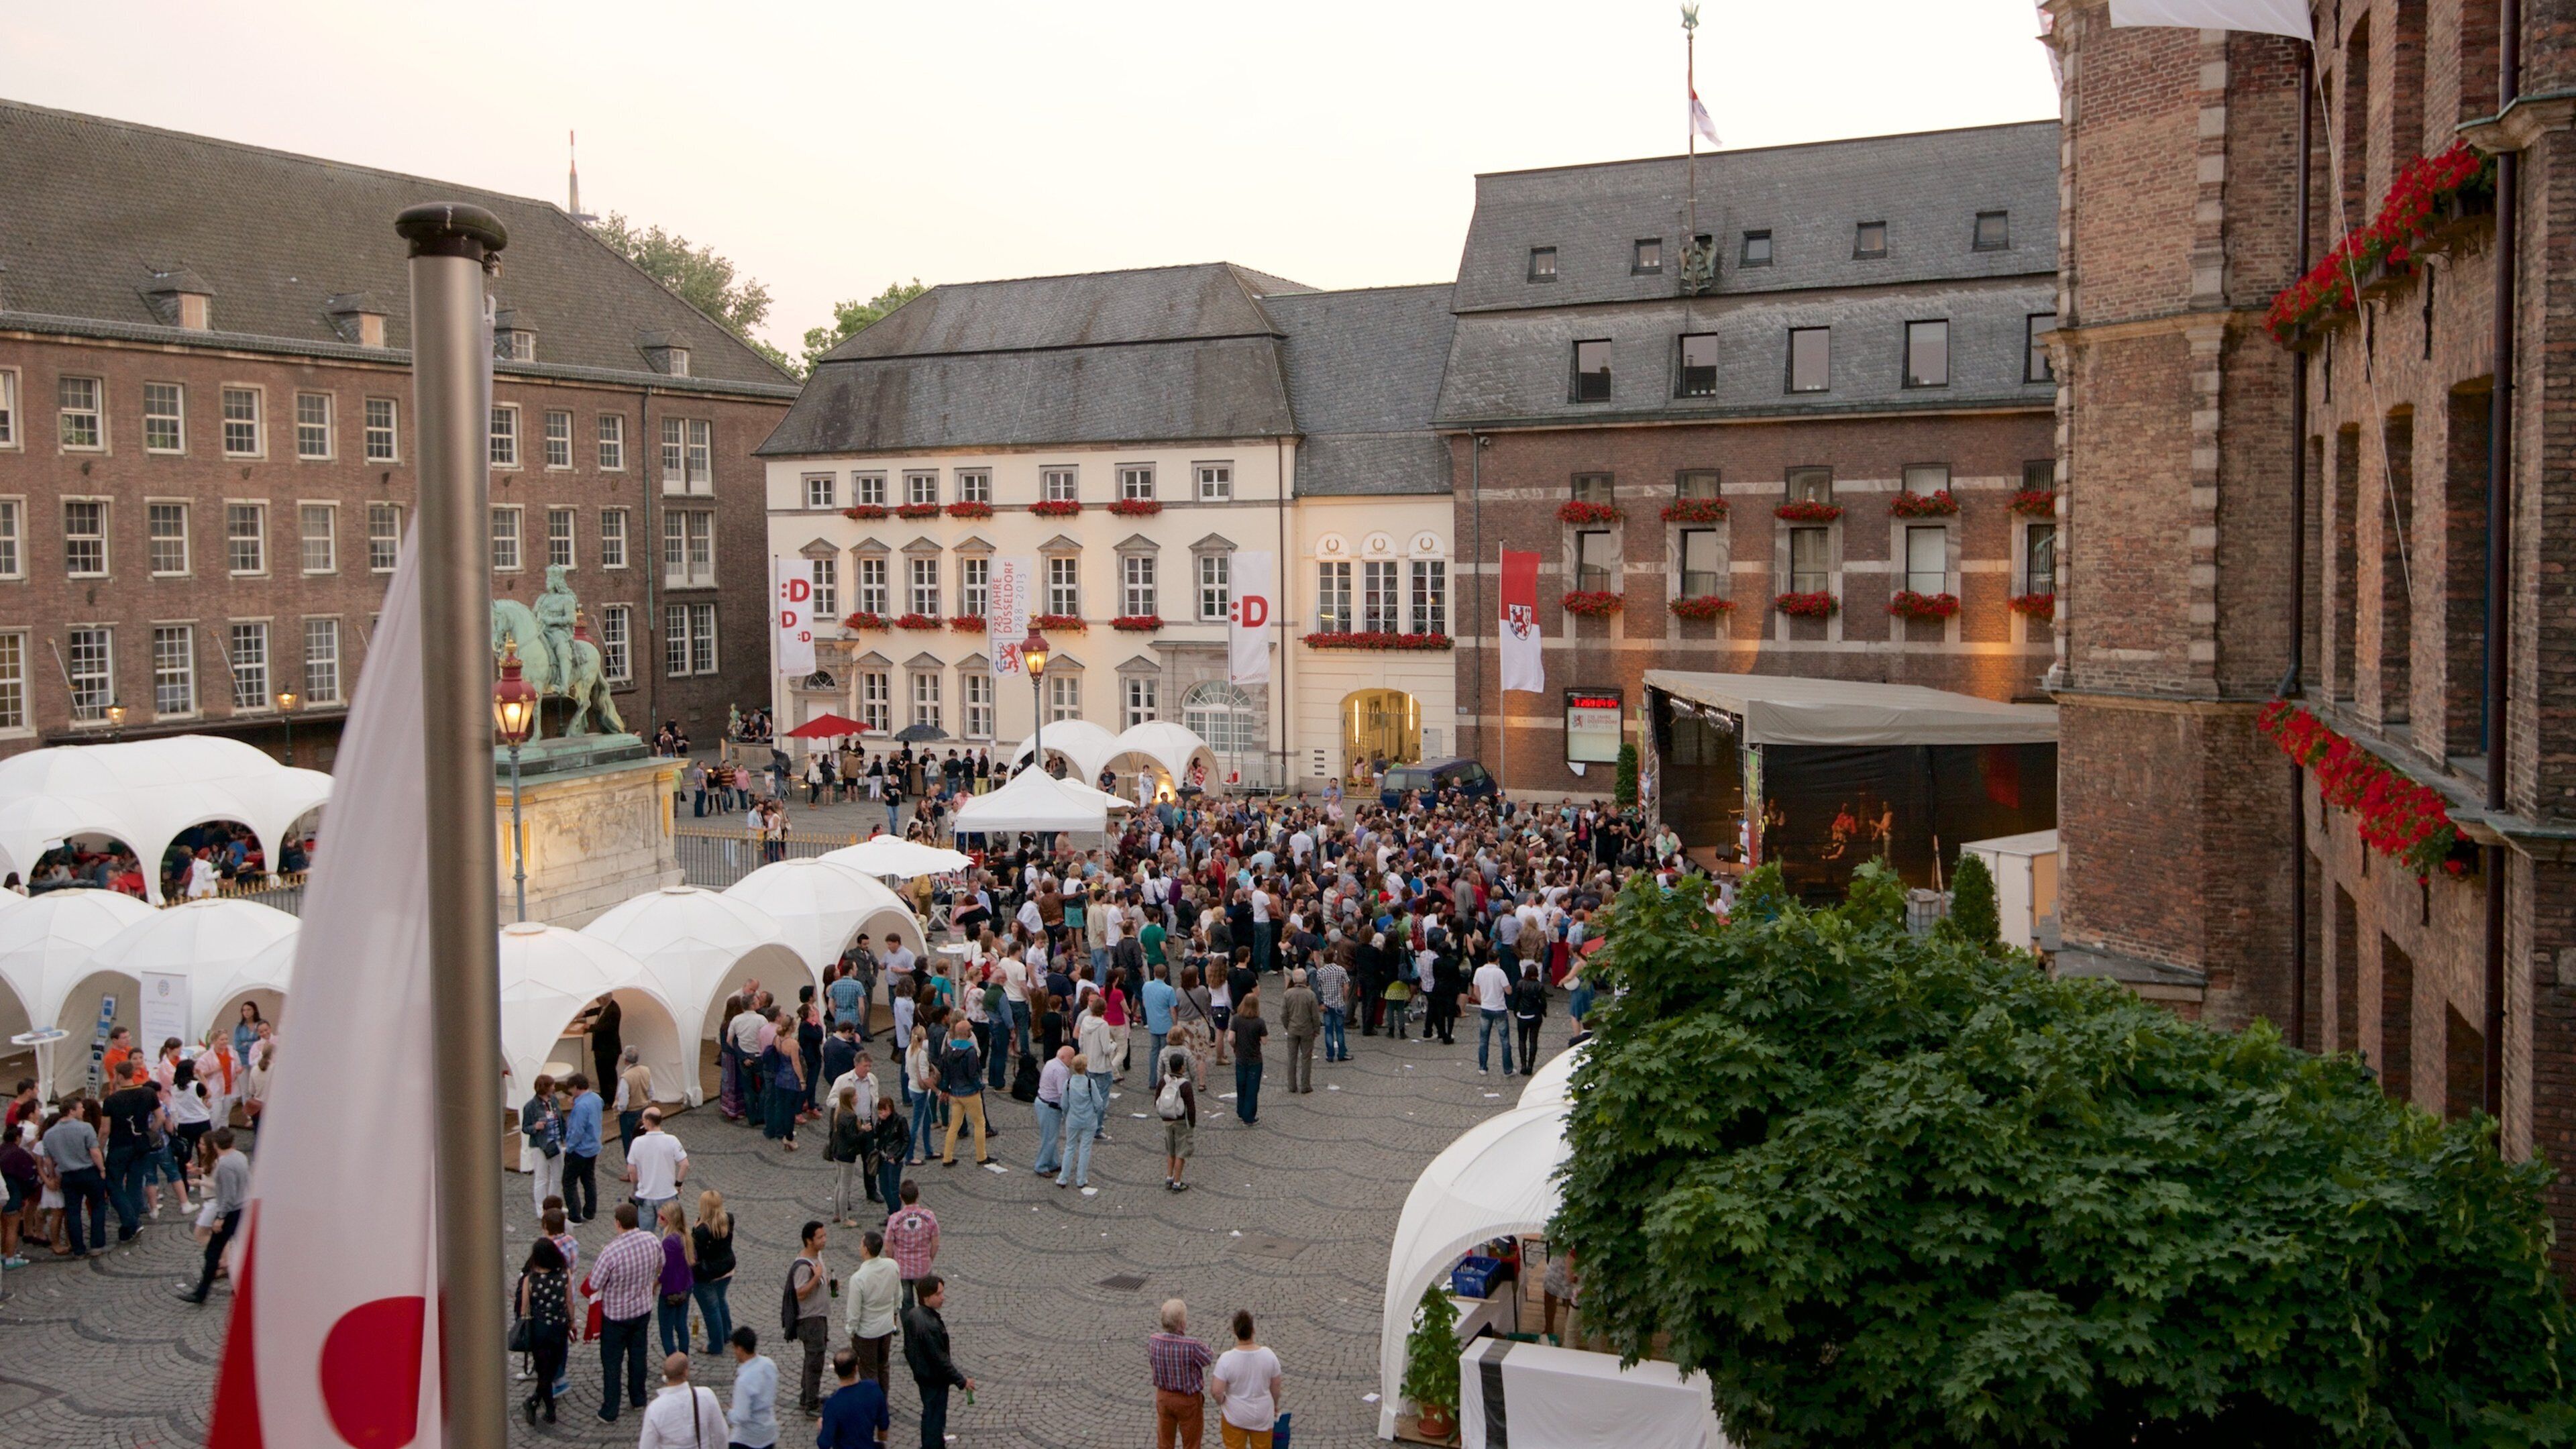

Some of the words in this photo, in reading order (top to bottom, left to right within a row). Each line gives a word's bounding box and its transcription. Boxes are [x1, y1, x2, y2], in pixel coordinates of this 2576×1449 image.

[782, 579, 810, 602] :D
[993, 578, 1002, 610] JAHRE
[1002, 561, 1014, 633] DÜSSELDORF
[994, 615, 1003, 633] 725
[1231, 596, 1268, 627] :D
[798, 631, 811, 643] :D
